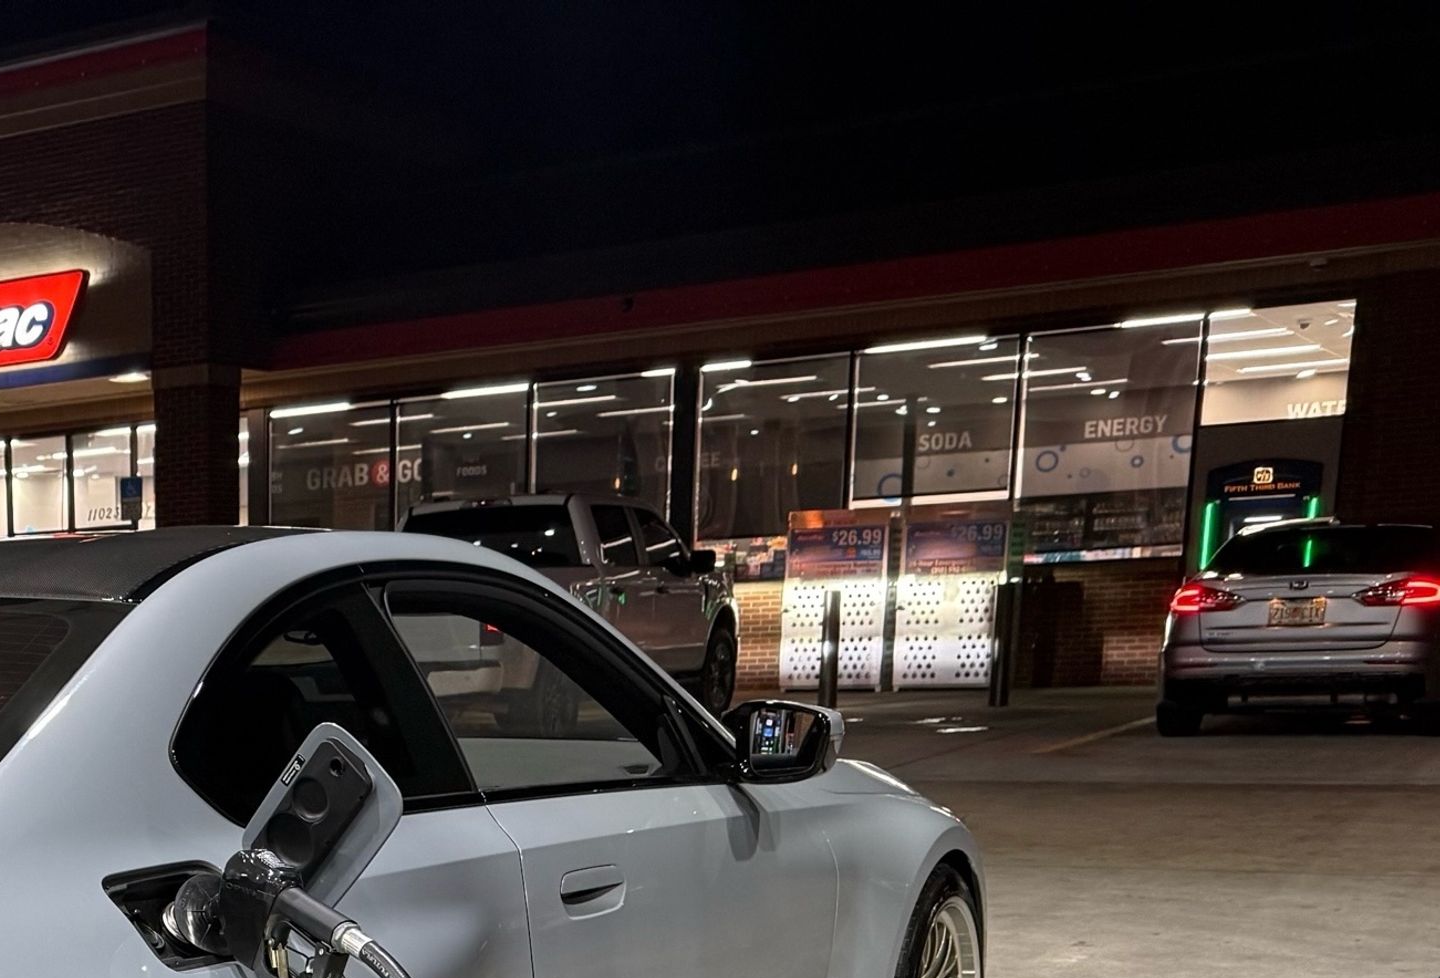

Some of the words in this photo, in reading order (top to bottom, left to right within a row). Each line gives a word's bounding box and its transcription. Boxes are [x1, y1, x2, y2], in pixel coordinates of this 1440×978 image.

[1084, 415, 1167, 439] ENERGY
[918, 432, 972, 451] SODA
[306, 463, 369, 490] GRAB
[1224, 484, 1248, 493] FIFTH
[832, 529, 882, 546] $26.99
